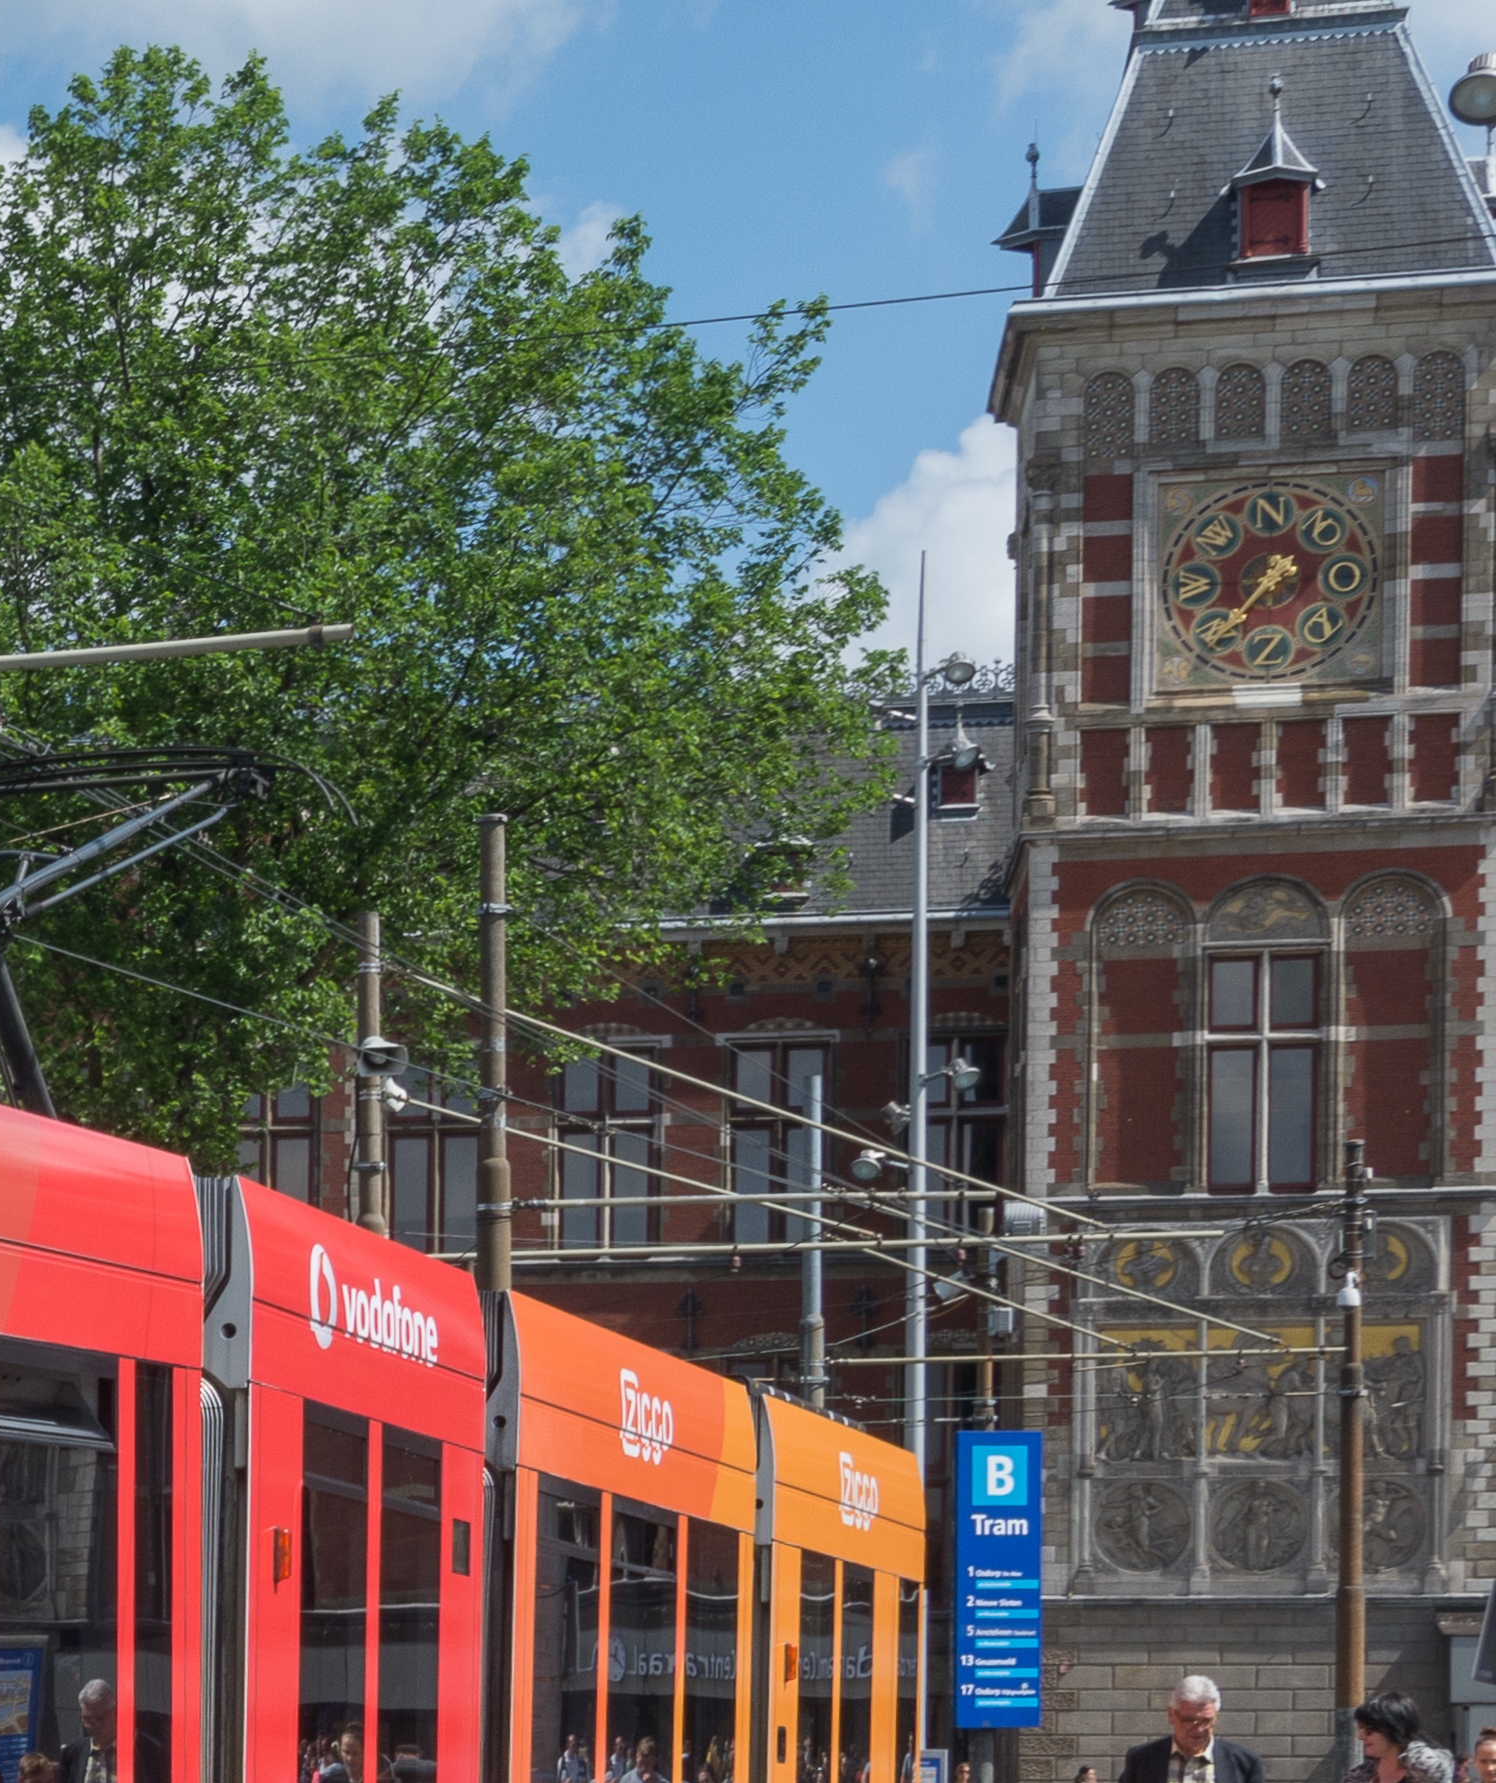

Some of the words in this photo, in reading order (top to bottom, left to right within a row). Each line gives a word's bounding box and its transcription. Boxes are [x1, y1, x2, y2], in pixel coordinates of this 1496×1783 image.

[1255, 497, 1286, 529] N
[342, 1278, 438, 1368] vodafone
[987, 1455, 1014, 1496] B
[971, 1515, 1028, 1536] Tram
[967, 1565, 974, 1577] 1
[966, 1595, 974, 1607] 2
[966, 1625, 974, 1636] 5
[960, 1654, 974, 1666] 13
[960, 1684, 974, 1696] 17
